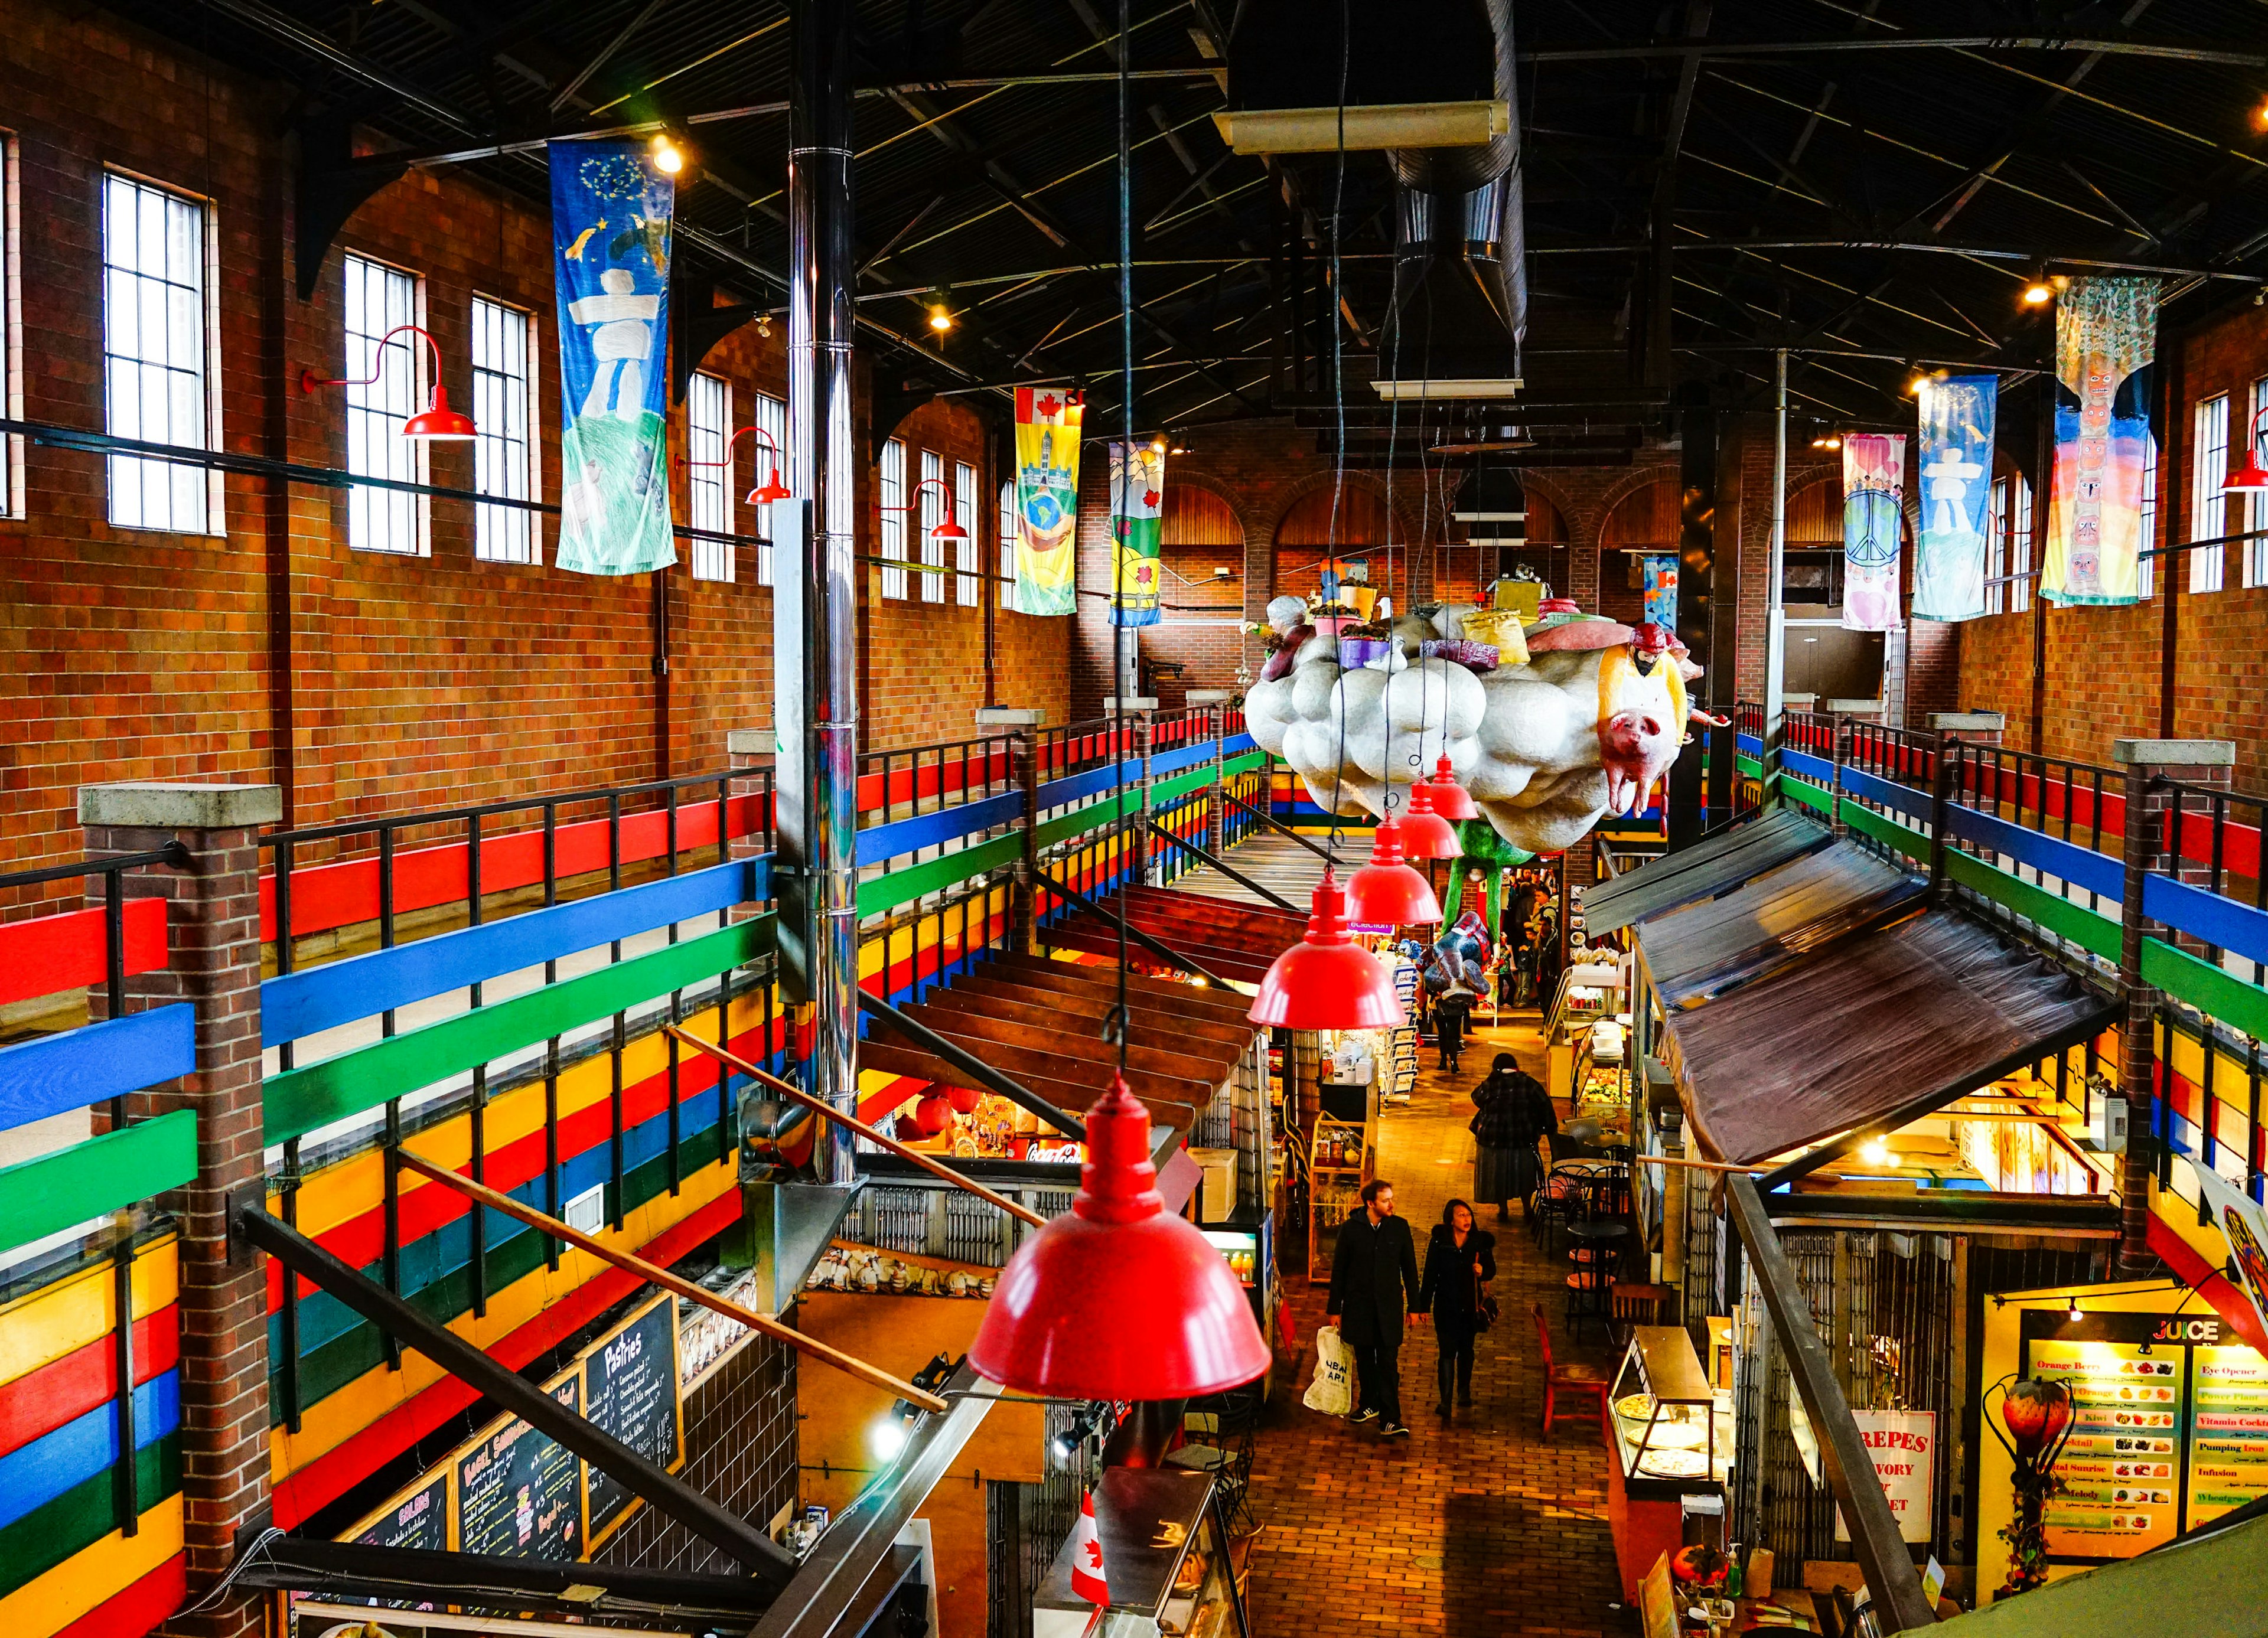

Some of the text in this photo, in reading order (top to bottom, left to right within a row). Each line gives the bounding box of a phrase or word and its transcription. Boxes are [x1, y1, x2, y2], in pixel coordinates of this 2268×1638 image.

[2153, 1320, 2219, 1341] JUICE
[604, 1332, 641, 1379] Pastries
[2037, 1360, 2100, 1372] Orange Berry
[2201, 1365, 2257, 1376] Eye Opener
[2078, 1388, 2113, 1398] Orange
[2085, 1414, 2107, 1422] Kiwi
[2200, 1417, 2237, 1426] Vitamin
[1860, 1431, 1928, 1453] REPES
[2199, 1443, 2241, 1453] Pumping
[1873, 1463, 1915, 1476] VORY
[2070, 1464, 2106, 1473] Sunrise
[2198, 1468, 2237, 1477] Infusion
[398, 1490, 430, 1527] SALADS
